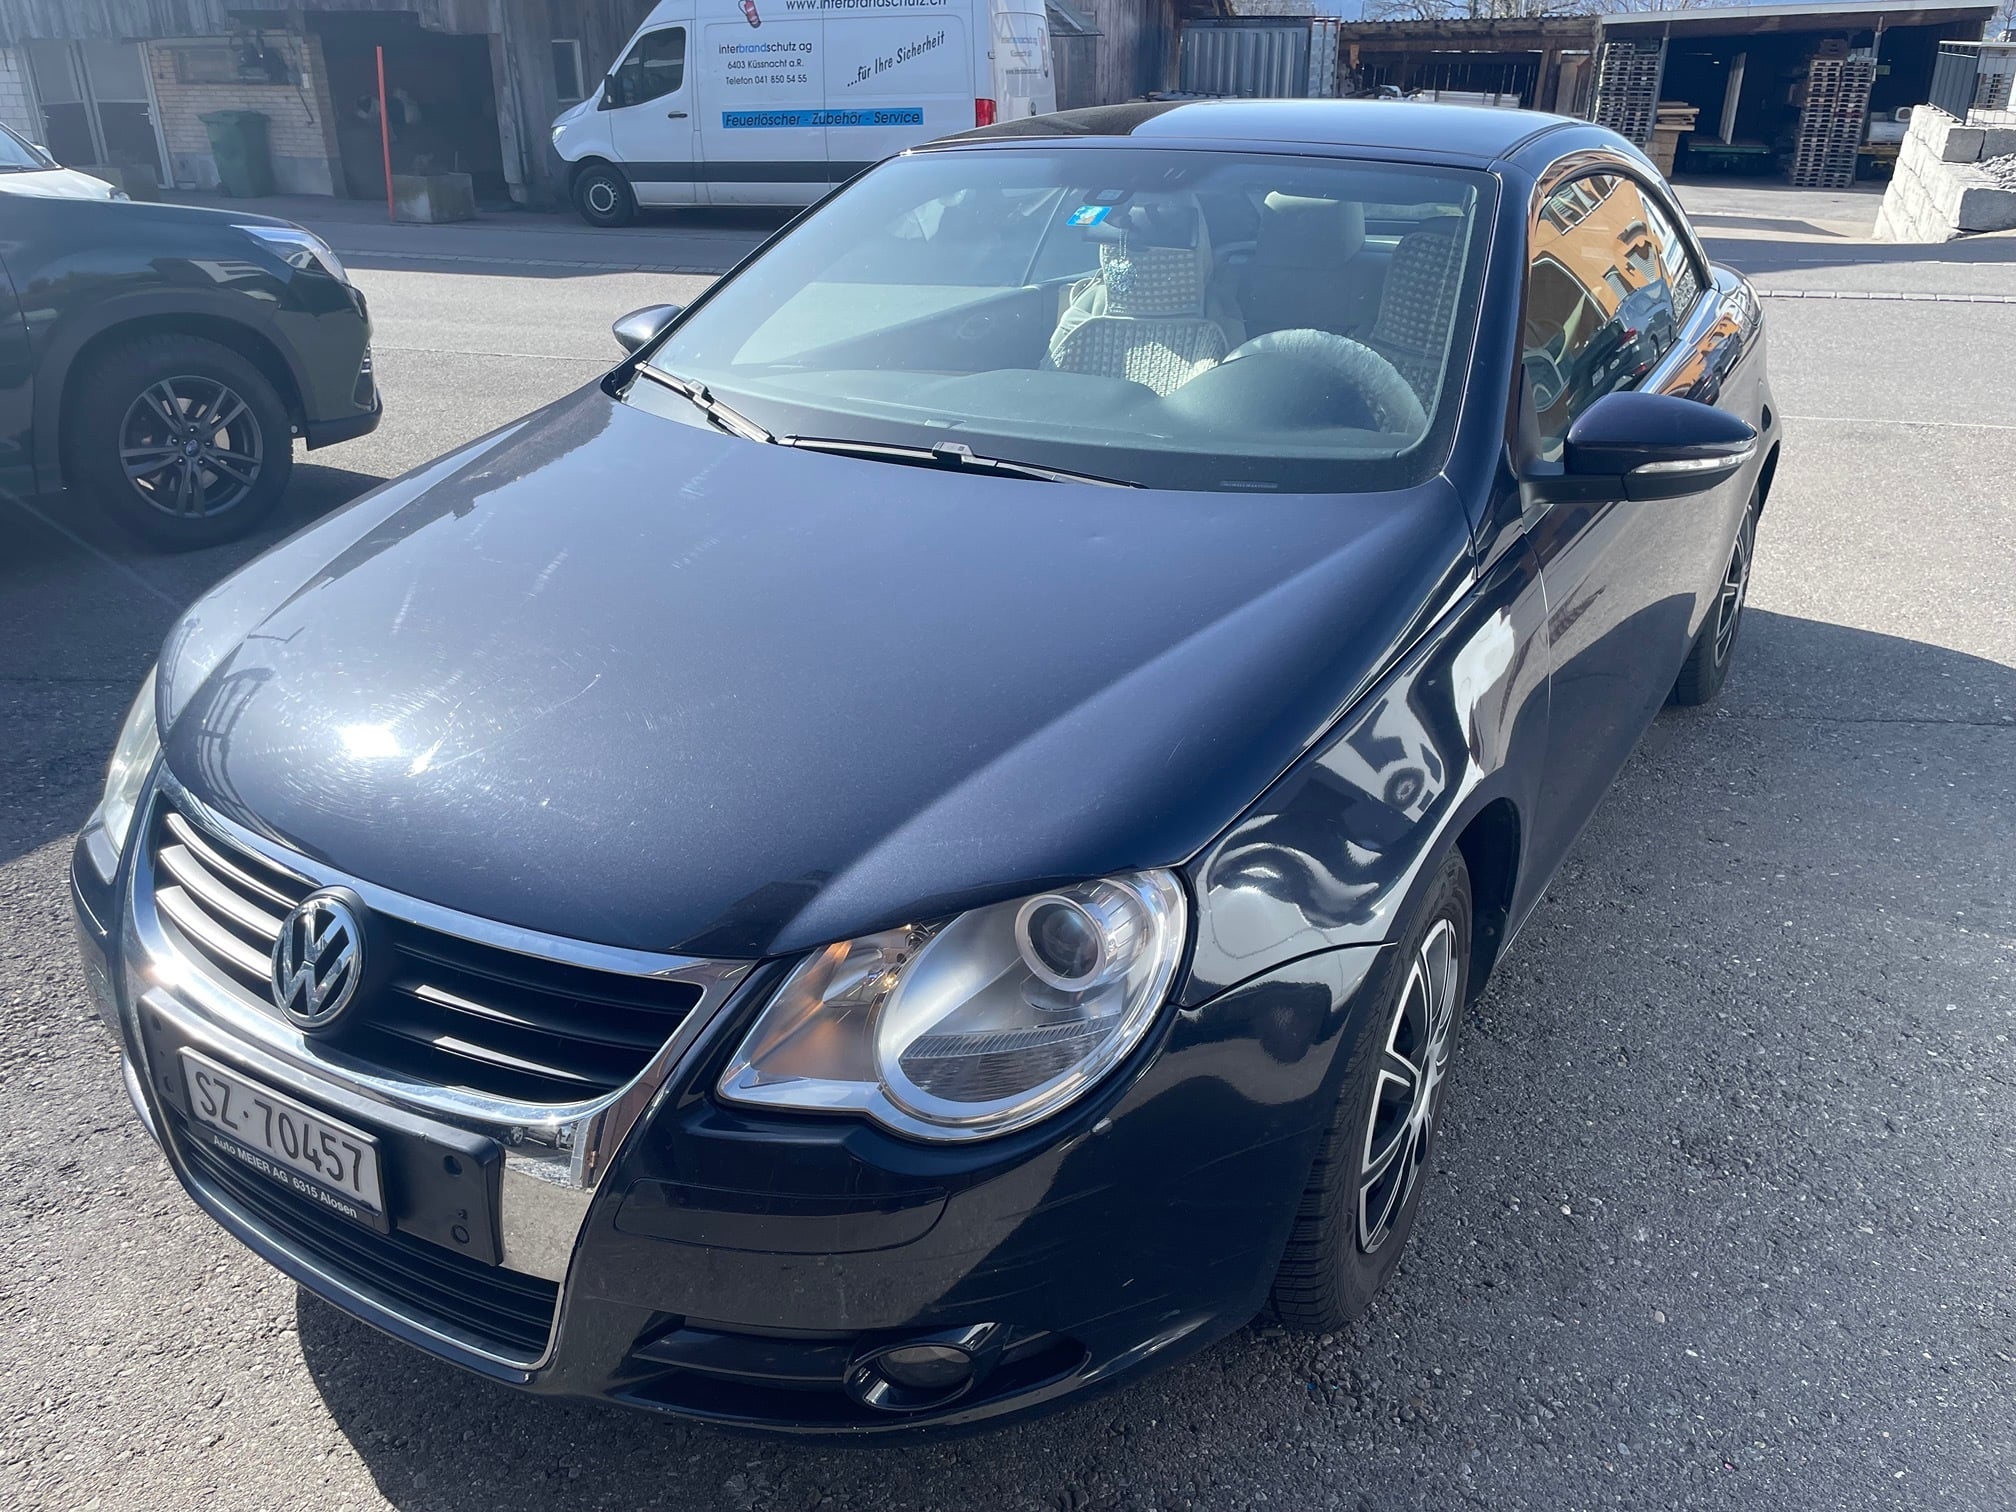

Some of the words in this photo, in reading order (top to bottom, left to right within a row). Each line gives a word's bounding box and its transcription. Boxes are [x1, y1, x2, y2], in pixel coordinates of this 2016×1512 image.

[719, 41, 796, 54] interbrandschutz
[798, 42, 812, 53] ag
[874, 56, 893, 75] Ihre
[896, 30, 945, 64] Sicherheit
[727, 62, 746, 70] 6403
[747, 58, 787, 69] Küssnacht
[726, 75, 753, 85] Telefon
[754, 75, 768, 84] 041
[770, 74, 784, 84] 850
[786, 74, 796, 83] 54
[797, 73, 808, 83] 55
[725, 113, 800, 127] Feuerlöscher
[811, 112, 862, 125] Zubehör
[873, 111, 920, 124] Service
[213, 1134, 236, 1156] Auto
[237, 1147, 271, 1174] MEIER
[272, 1166, 289, 1184] AG
[292, 1176, 318, 1199] 6315
[320, 1190, 358, 1220] Alosen
